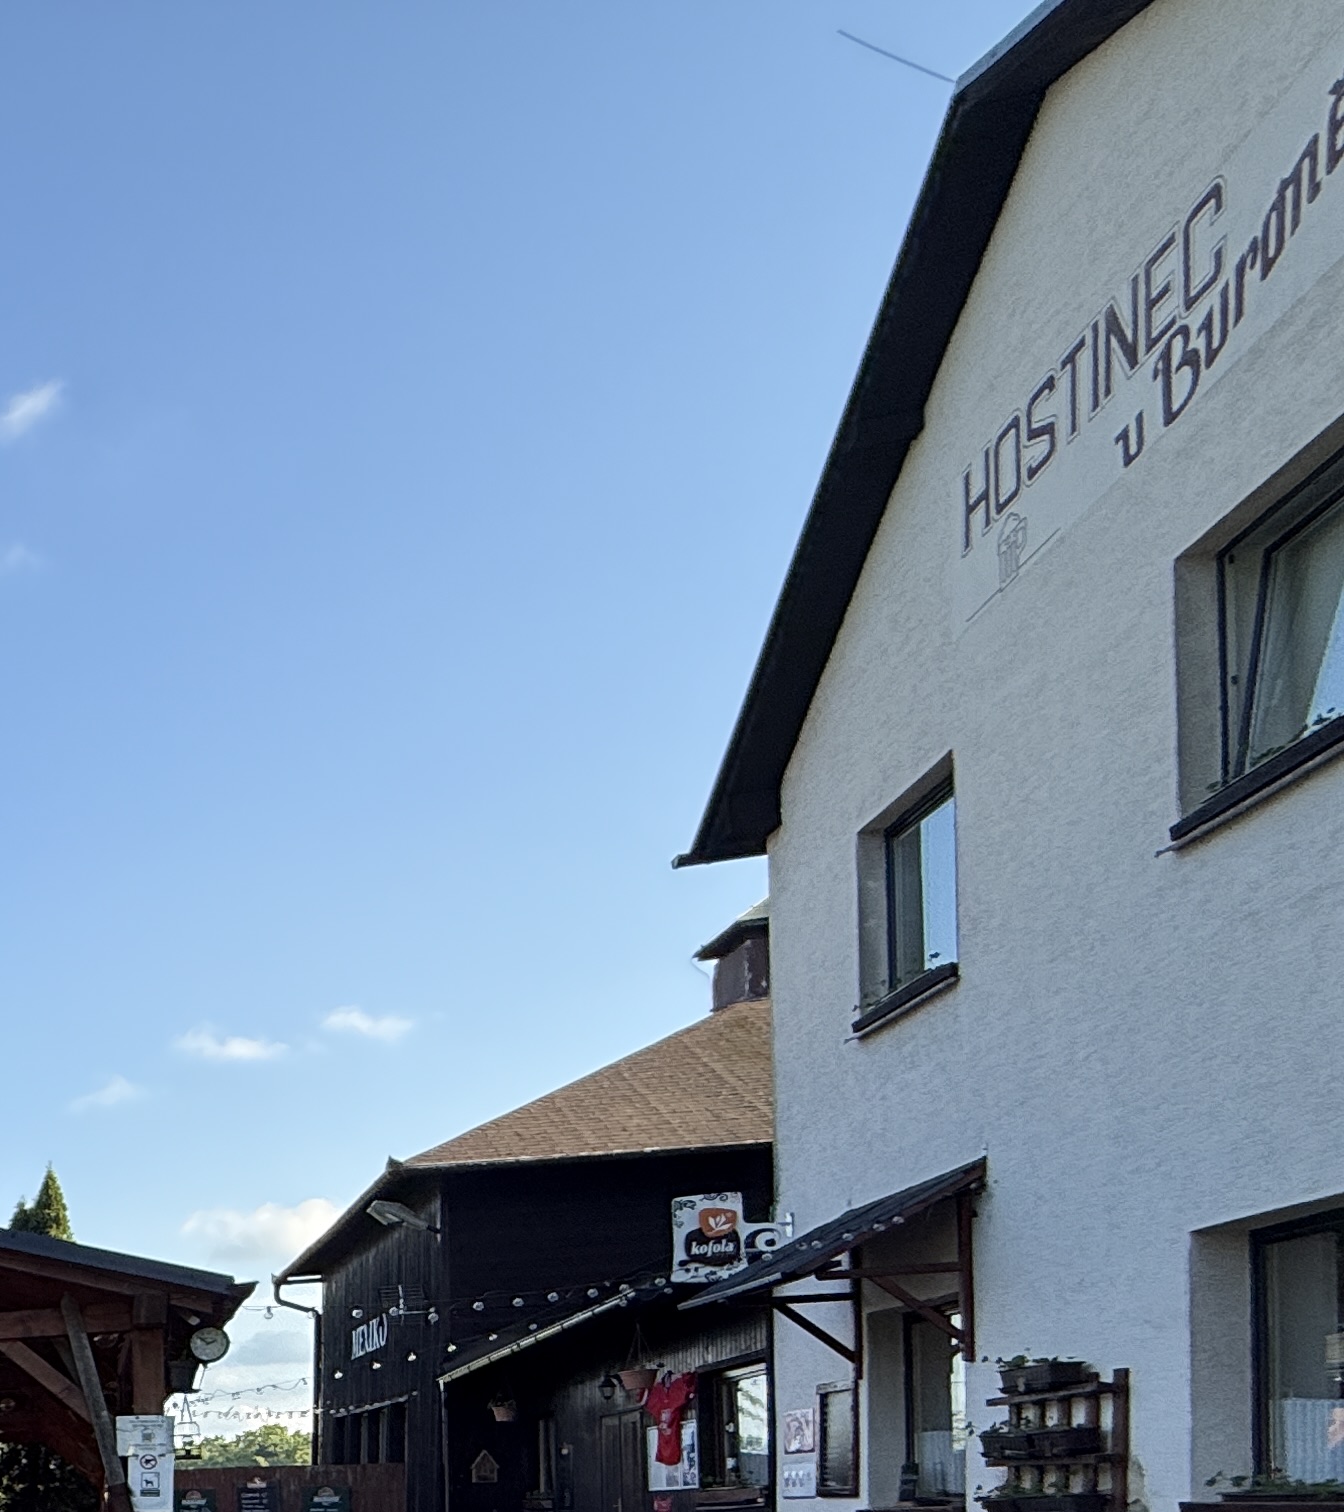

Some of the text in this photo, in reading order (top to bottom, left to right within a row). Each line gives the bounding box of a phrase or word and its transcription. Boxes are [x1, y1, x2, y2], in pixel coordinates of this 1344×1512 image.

[960, 176, 1227, 558] HOSTINEC
[1114, 409, 1145, 469] u
[690, 1238, 734, 1257] kofola
